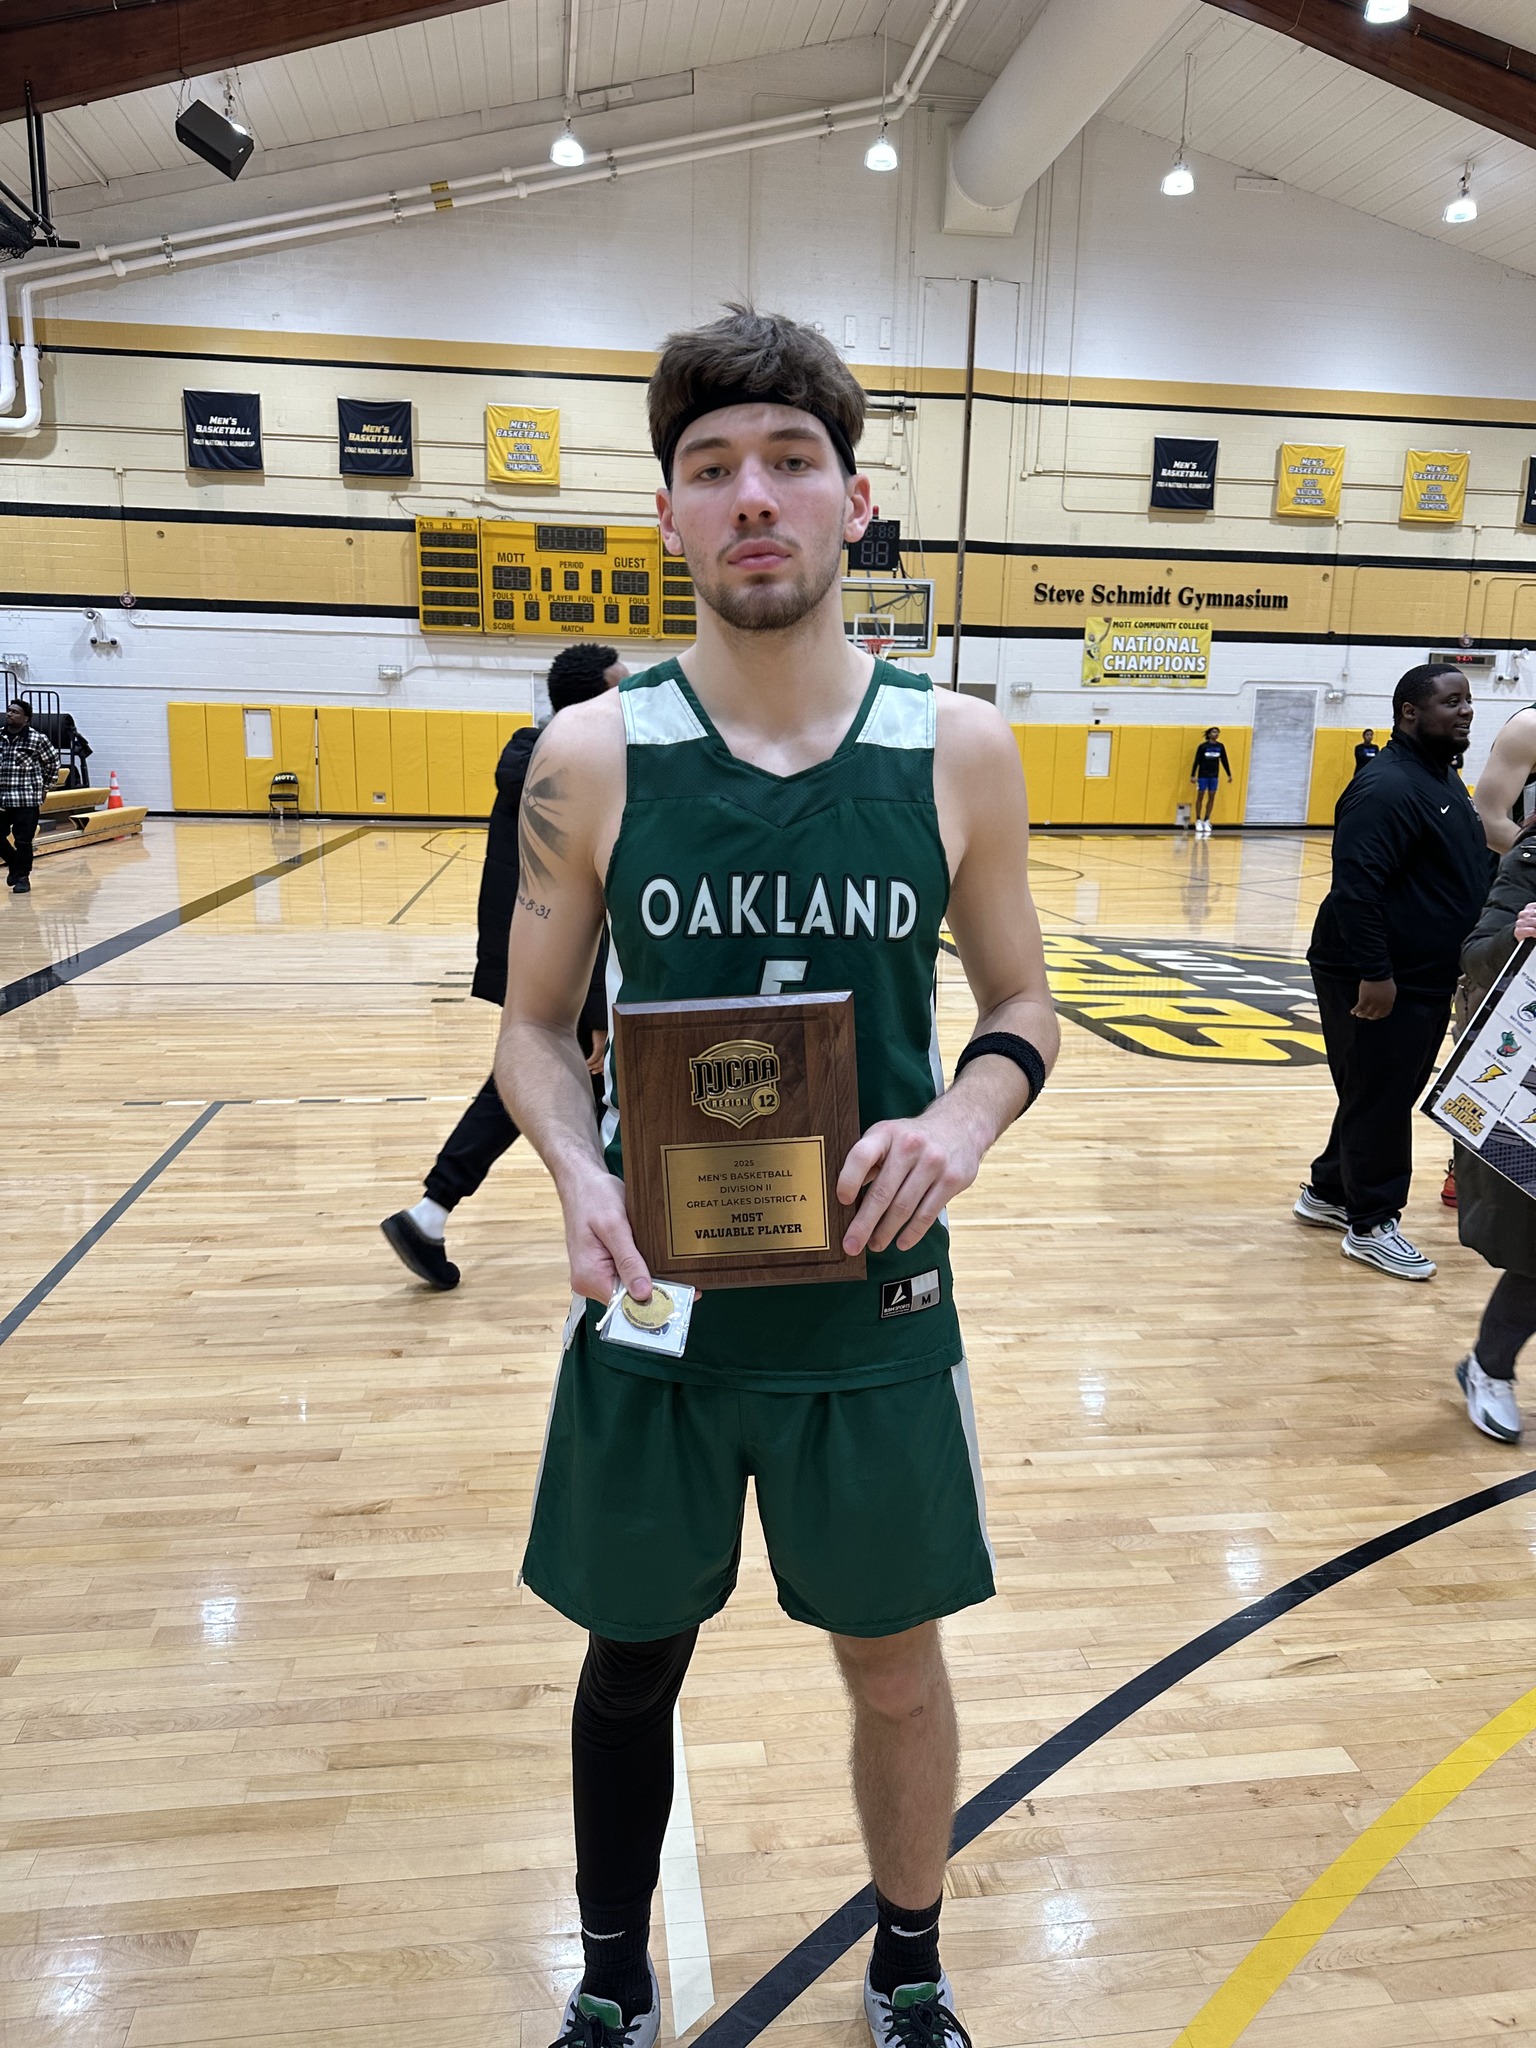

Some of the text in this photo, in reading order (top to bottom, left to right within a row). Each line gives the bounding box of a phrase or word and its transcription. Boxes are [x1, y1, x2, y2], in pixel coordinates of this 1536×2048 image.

[209, 416, 238, 426] MEN'S
[509, 420, 537, 430] MEN'S
[195, 424, 252, 435] BASKETBALL
[362, 424, 390, 434] MEN'S
[496, 428, 550, 440] BASKETBALL
[205, 439, 229, 447] NATIONAL
[348, 432, 403, 443] BASKETBALL
[358, 447, 381, 455] NATIONAL
[507, 452, 539, 462] NATIONAL
[1300, 457, 1325, 467] MEN'S
[505, 462, 542, 472] CHAMPIONS
[1173, 461, 1198, 470] MEN'S
[1288, 465, 1335, 476] BASKETBALL
[1425, 464, 1449, 472] MEN'S
[1161, 468, 1208, 478] BASKETBALL
[1412, 471, 1459, 482] BASKETBALL
[1292, 496, 1326, 505] CHAMPIONS
[1417, 501, 1450, 511] CHAMPIONS
[420, 521, 473, 531] PLYR FLS PTS
[497, 552, 525, 563] MOTT
[613, 557, 647, 569] GUEST
[559, 561, 584, 569] PERIOD
[492, 592, 515, 600] FOULS
[547, 594, 573, 602] PLAYER
[578, 595, 595, 603] FOUL
[629, 597, 650, 605] FOULS
[1034, 582, 1289, 612] Steve Schmidt Gymnasium
[493, 622, 650, 635] SCORE MATCH SCORE
[1112, 621, 1209, 630] MOTT COMMUNITY COLLEGE
[1111, 635, 1201, 653] NATIONAL
[1103, 654, 1207, 673] CHAMPIONS
[639, 873, 919, 940] OAKLAND
[1485, 1049, 1513, 1073] DELTA COLLEGE
[692, 1056, 777, 1101] NJCAA
[1468, 1086, 1488, 1101] UNIVERSITY
[711, 1094, 776, 1108] REGION 12
[1454, 1092, 1488, 1121] GRCC
[1440, 1097, 1486, 1137] RAIDERS
[733, 1159, 755, 1168] 2025
[698, 1169, 793, 1183] MEN'S BASKETBALL
[720, 1184, 763, 1194] DIVISION
[686, 1194, 807, 1209] GREAT LAKES DISTRICT A
[731, 1212, 764, 1223] MOST
[694, 1223, 803, 1239] VALUABLE PLAYER
[921, 1293, 932, 1305] M
